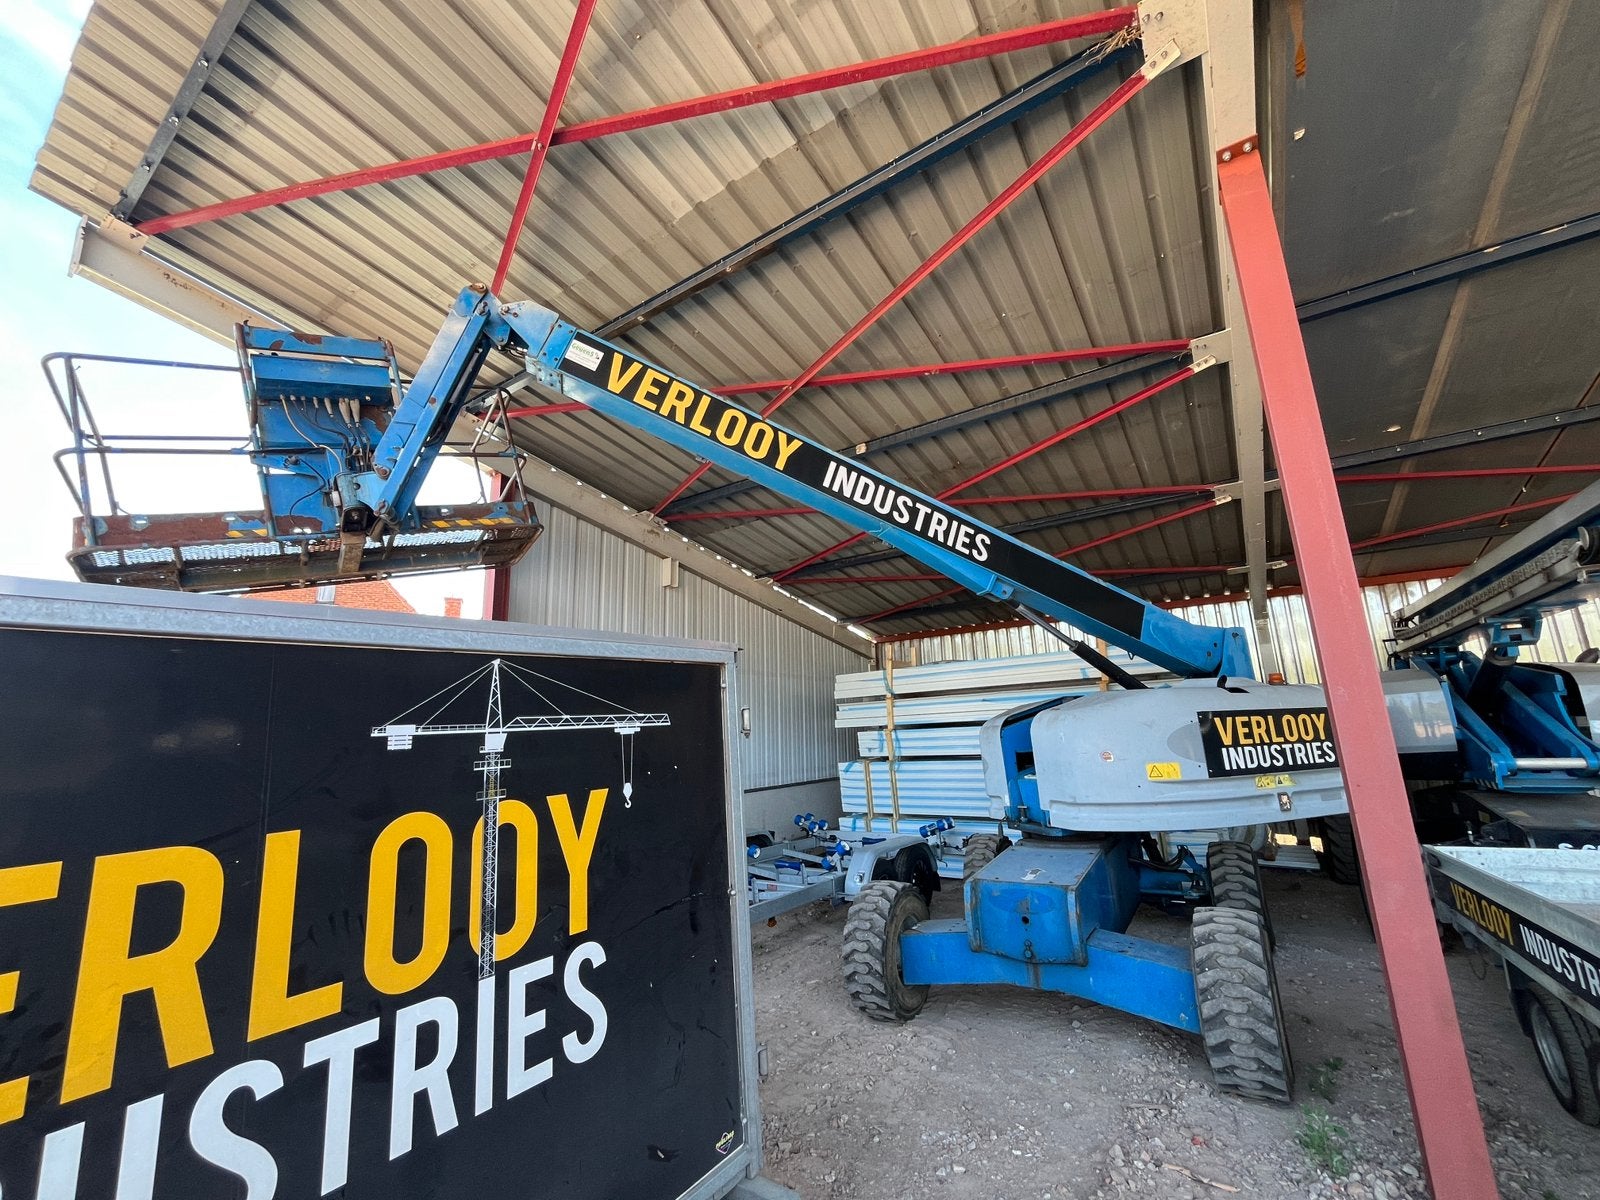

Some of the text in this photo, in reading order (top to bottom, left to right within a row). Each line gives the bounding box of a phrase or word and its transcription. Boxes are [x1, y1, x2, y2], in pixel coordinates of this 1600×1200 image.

[607, 352, 992, 563] VERLOOY INDUSTRIES
[1213, 713, 1328, 746] VERLOOY
[1221, 741, 1337, 771] INDUSTRIES
[1450, 881, 1514, 946] VERLOOY
